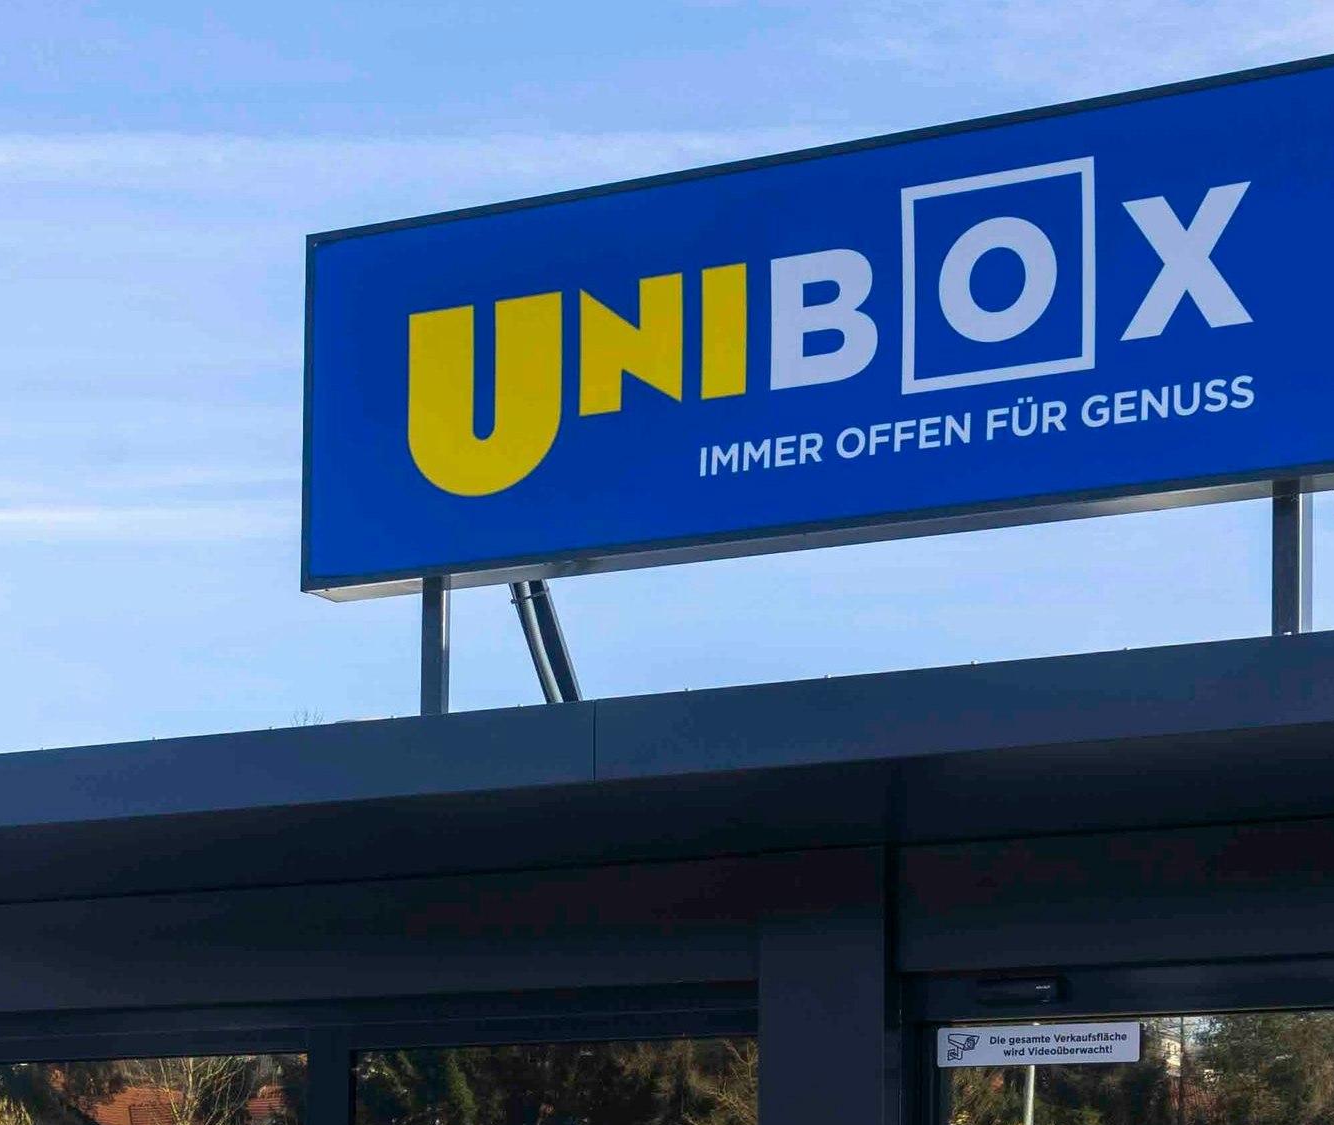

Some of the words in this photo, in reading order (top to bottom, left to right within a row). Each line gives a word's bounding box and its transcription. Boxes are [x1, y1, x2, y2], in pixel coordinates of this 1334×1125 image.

[408, 178, 1253, 497] UNIBOX
[699, 431, 824, 478] IMMER
[836, 412, 972, 460] OFFEN
[986, 396, 1068, 441] FÜR
[1080, 375, 1256, 428] GENUSS
[989, 1036, 1007, 1045] Die
[1008, 1035, 1051, 1046] gesamte
[1054, 1031, 1127, 1044] Verkaufsfläche
[1003, 1047, 1025, 1057] wird
[1028, 1045, 1113, 1057] Videoüberwacht!
